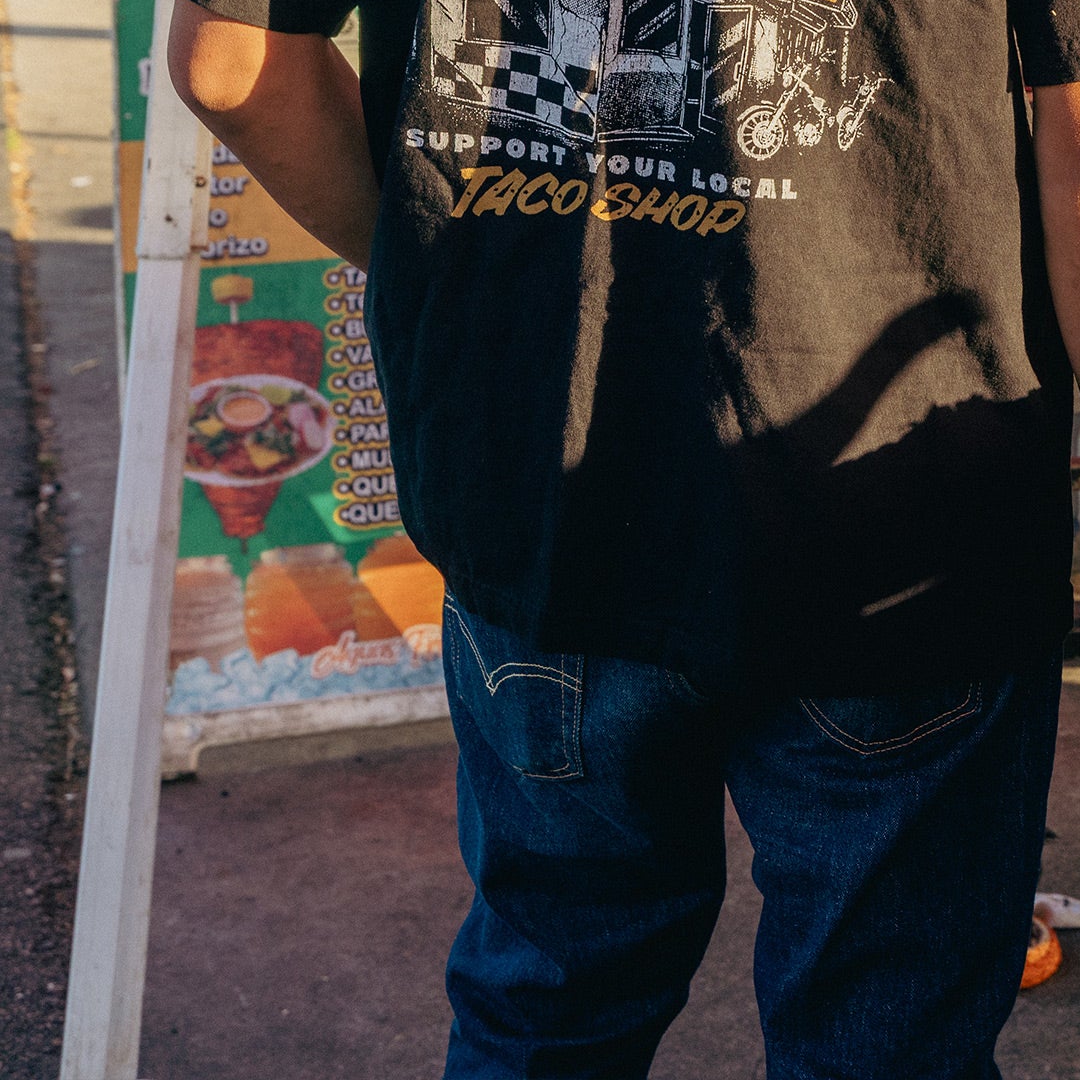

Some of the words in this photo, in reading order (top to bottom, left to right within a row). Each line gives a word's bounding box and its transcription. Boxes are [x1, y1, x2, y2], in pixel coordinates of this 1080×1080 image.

[405, 127, 567, 166] SUPPORT
[584, 152, 676, 182] YOUR
[691, 168, 798, 201] LOCAL
[450, 166, 589, 219] TACO
[590, 183, 748, 237] SHOP
